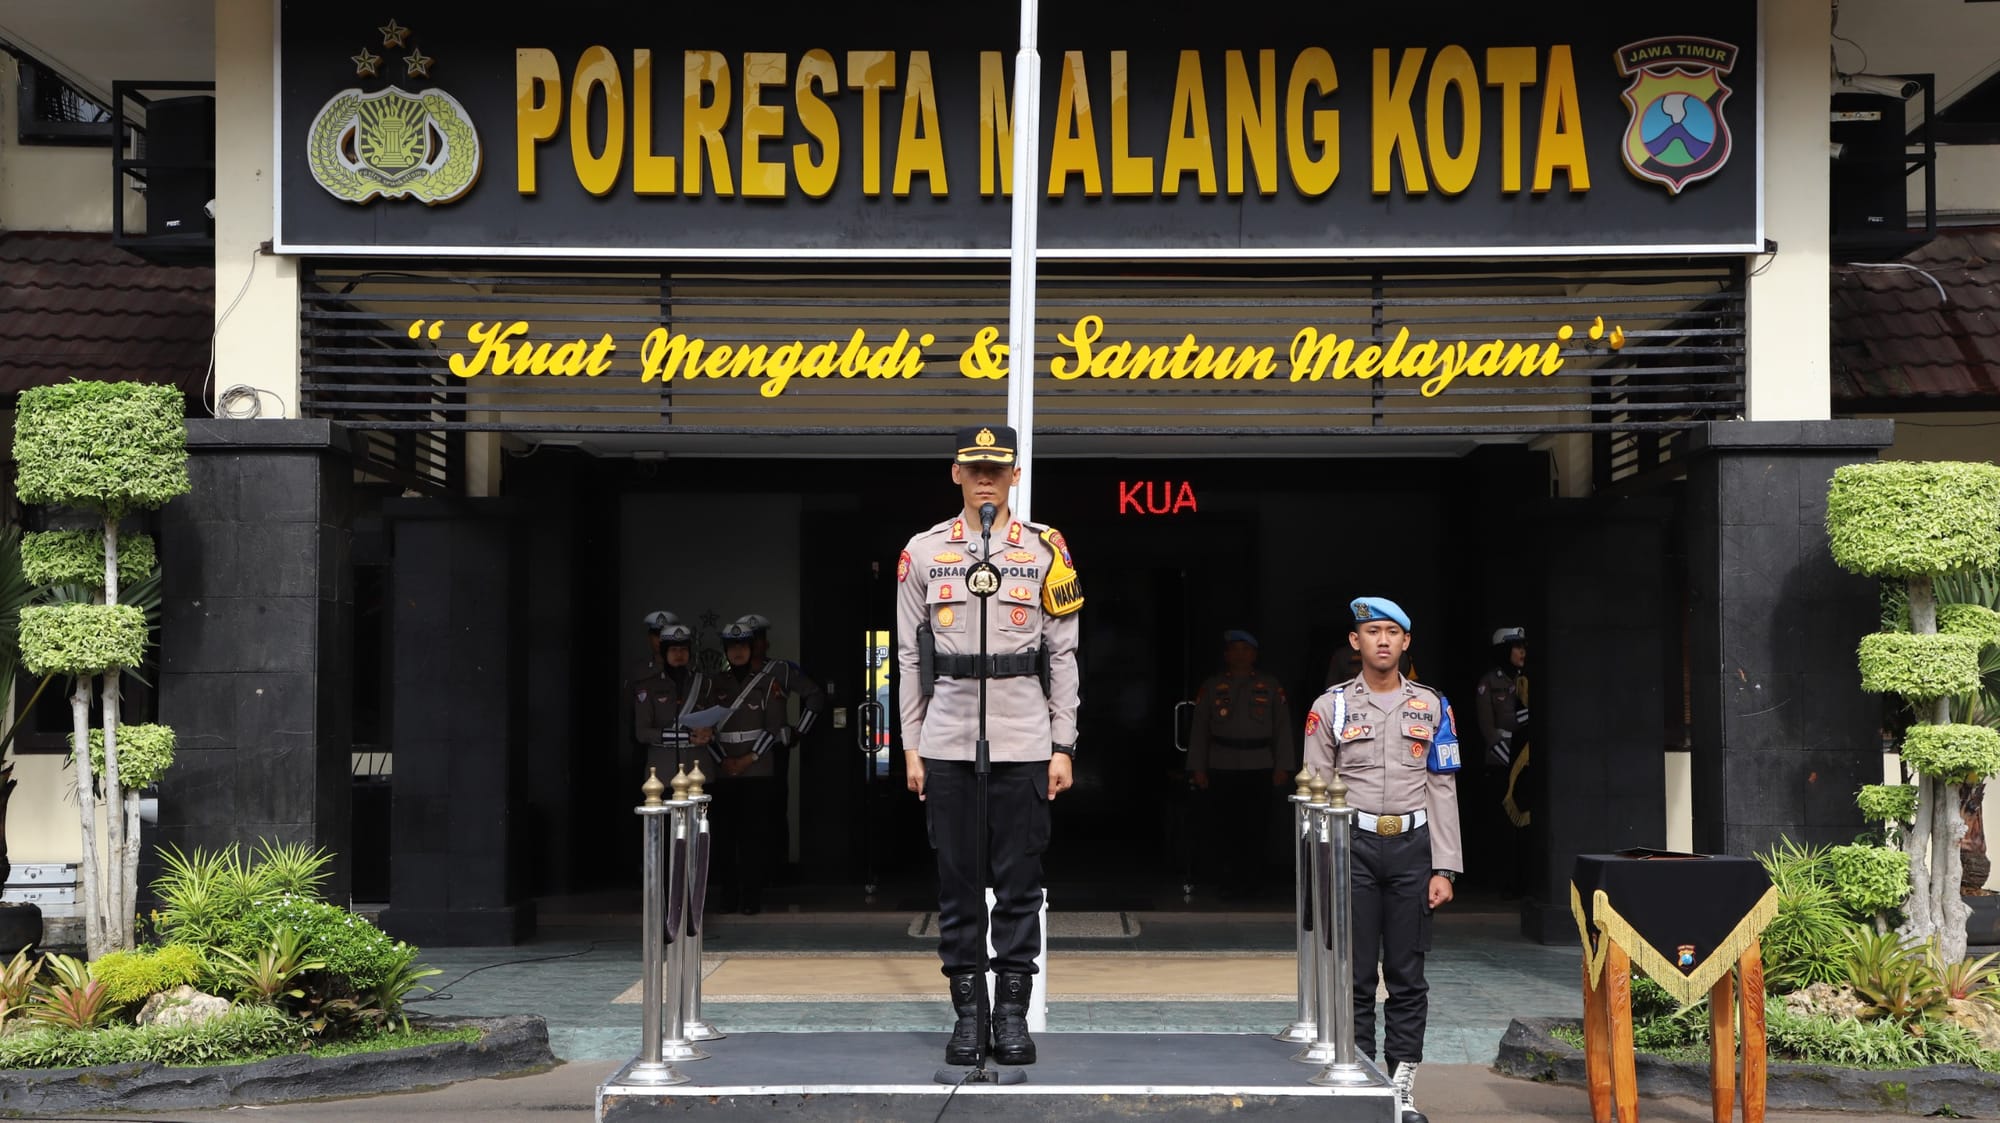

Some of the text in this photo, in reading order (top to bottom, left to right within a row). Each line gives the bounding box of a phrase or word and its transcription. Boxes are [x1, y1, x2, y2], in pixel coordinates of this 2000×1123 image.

[1630, 44, 1727, 62] JAWA TIMUR
[516, 45, 1590, 197] POLRESTA MALANG KOTA
[641, 328, 934, 397] Mengabdi
[959, 326, 1010, 379] &
[1050, 315, 1277, 381] Santun
[1119, 481, 1197, 514] KUA
[929, 566, 966, 579] OSKAR
[1001, 567, 1038, 579] POLRI
[1402, 711, 1433, 722] POLRI
